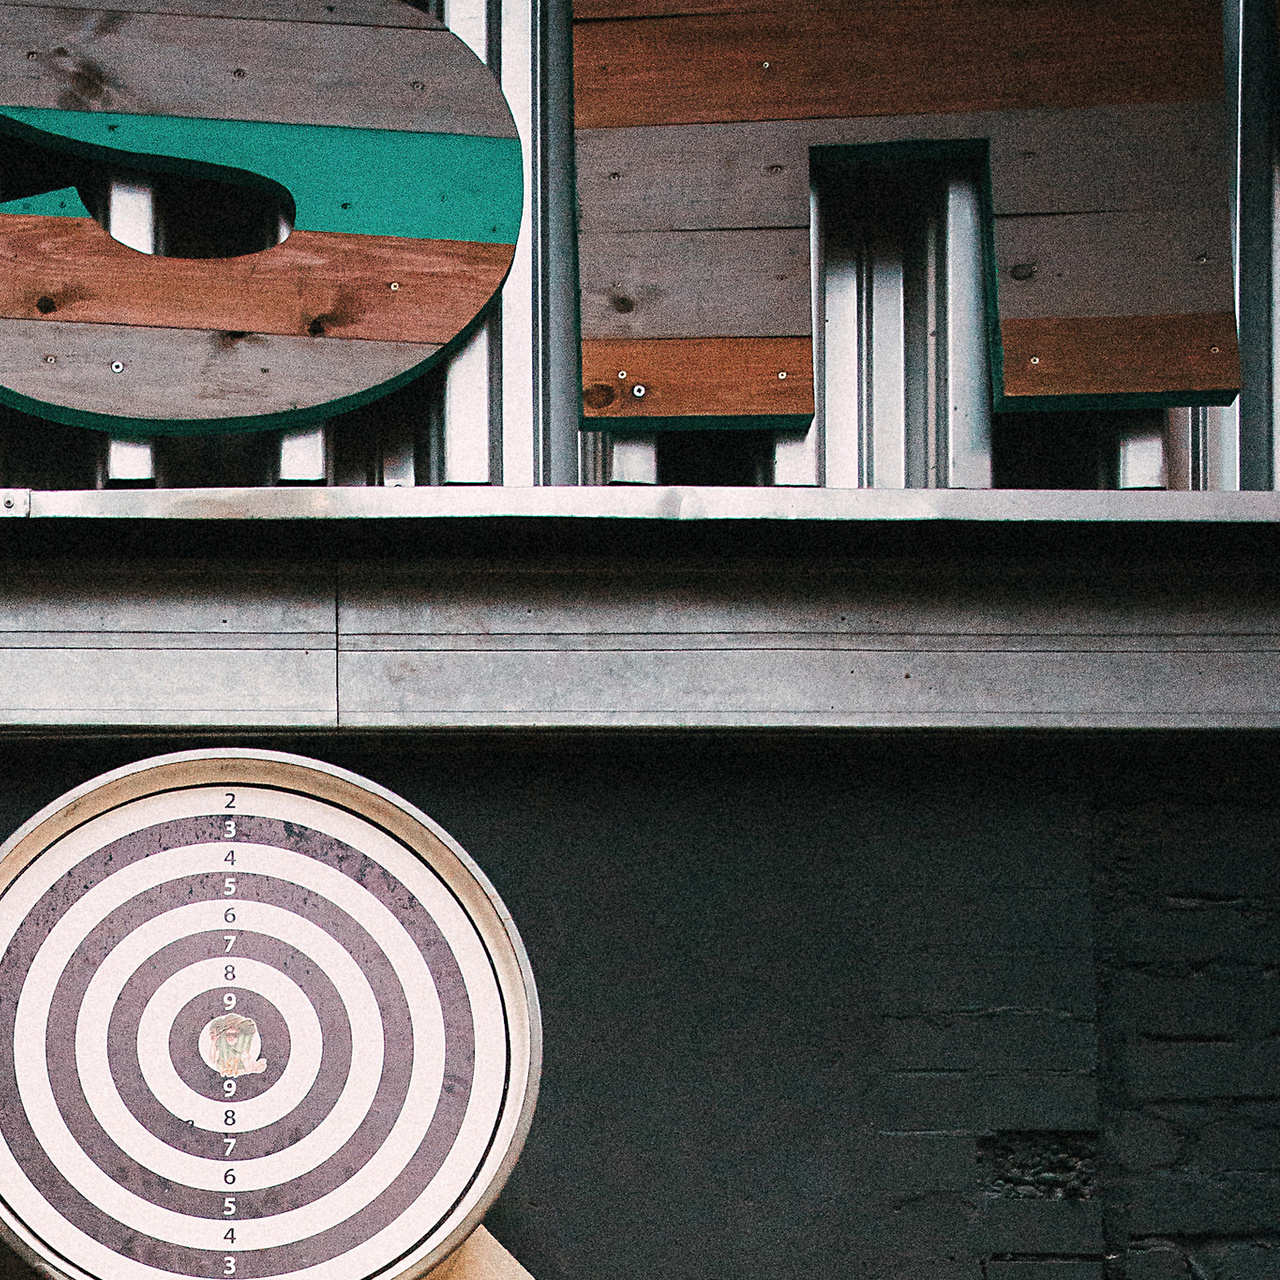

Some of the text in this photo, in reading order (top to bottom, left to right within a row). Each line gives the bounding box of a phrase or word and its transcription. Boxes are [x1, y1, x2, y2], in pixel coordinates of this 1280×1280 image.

[223, 792, 237, 809] 2
[223, 820, 237, 837] 3
[223, 849, 237, 866] 4
[223, 878, 237, 895] 5
[223, 906, 237, 923] 6
[223, 935, 237, 952] 7
[223, 964, 237, 981] 8
[223, 993, 237, 1010] 9
[223, 1079, 237, 1096] 9
[223, 1109, 237, 1126] 8
[223, 1138, 237, 1155] 7
[223, 1168, 237, 1185] 6
[223, 1197, 237, 1214] 5
[223, 1227, 237, 1244] 4
[223, 1256, 237, 1273] 3
